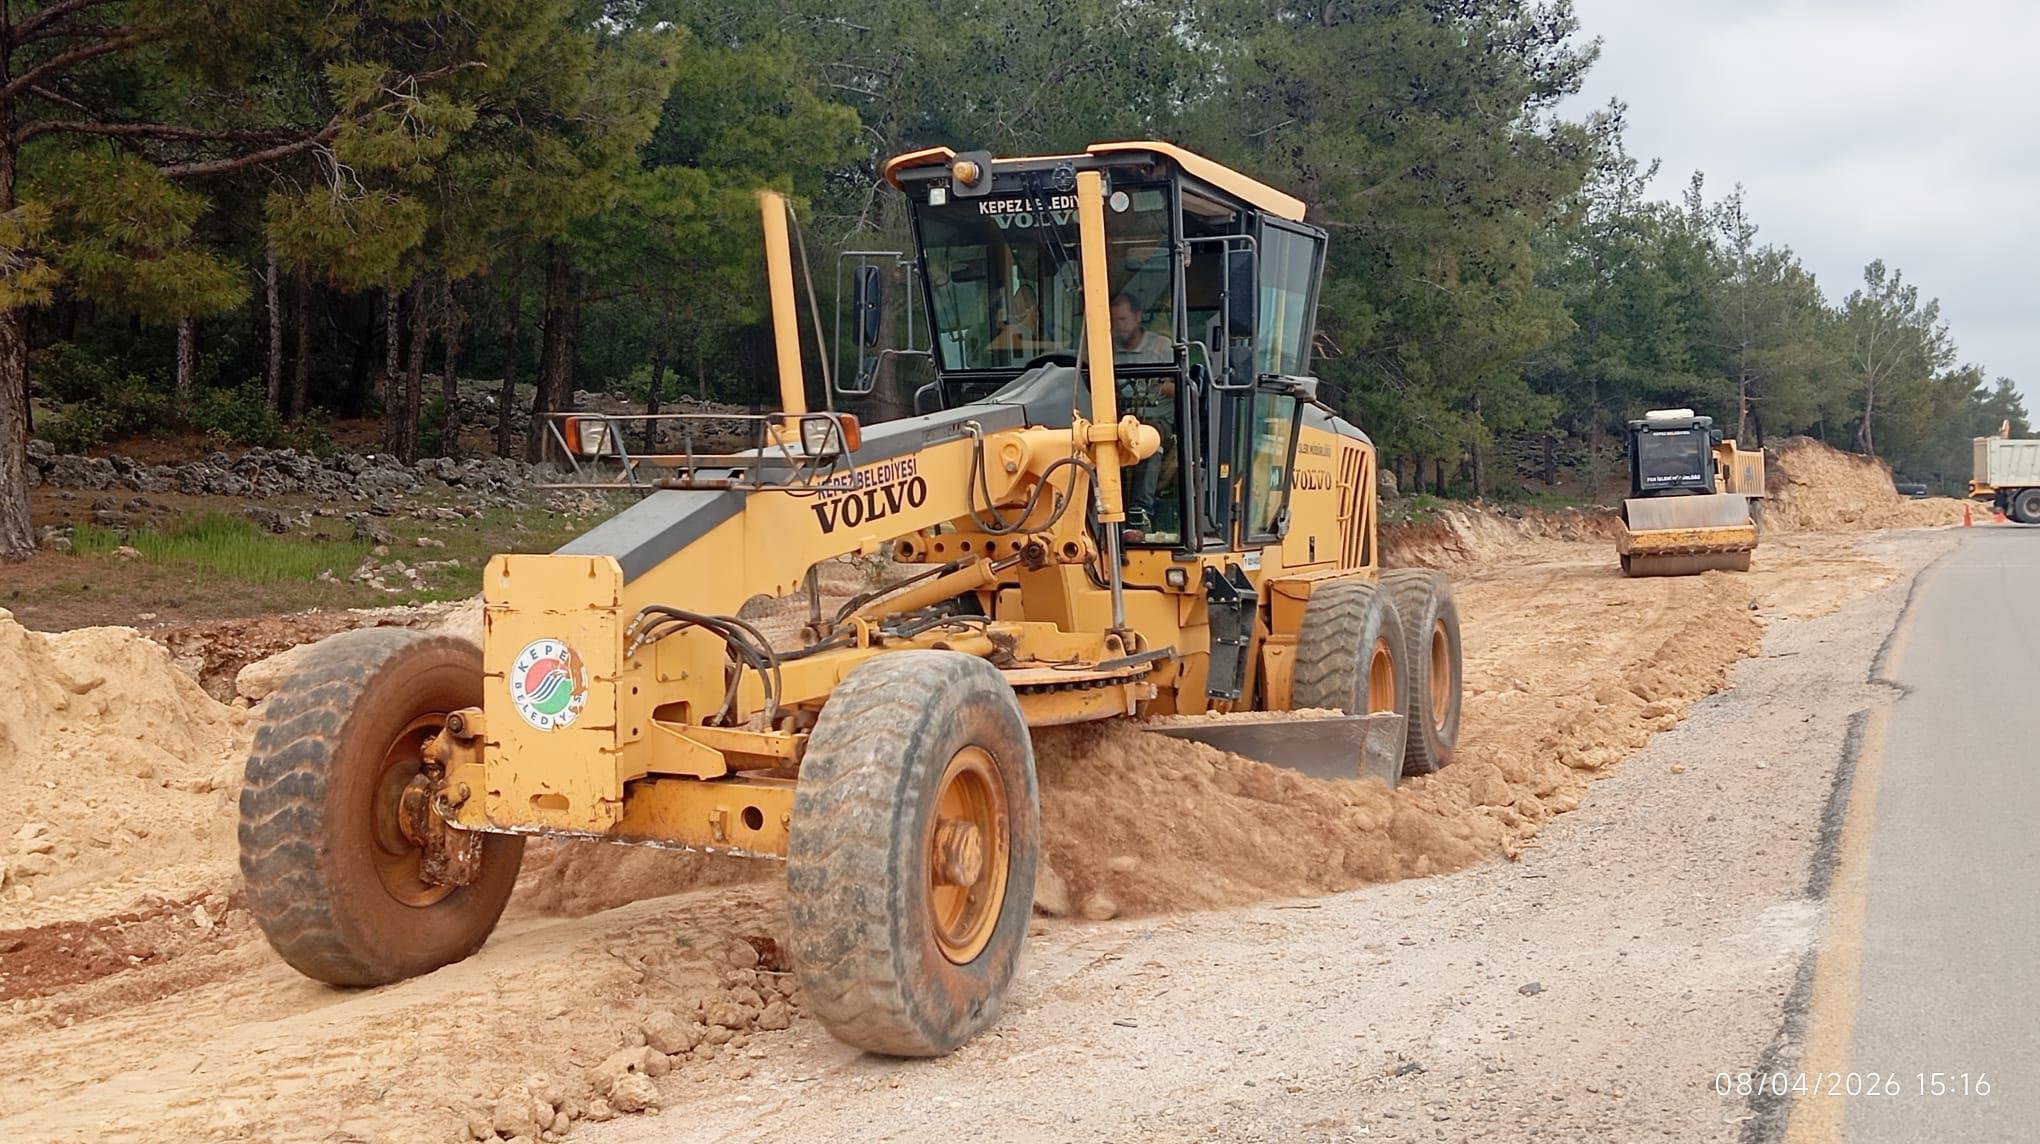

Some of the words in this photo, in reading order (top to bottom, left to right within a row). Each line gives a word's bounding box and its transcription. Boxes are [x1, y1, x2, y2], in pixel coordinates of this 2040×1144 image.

[978, 199, 1023, 215] KEPEZ
[1292, 469, 1331, 490] VOLVO
[811, 476, 927, 534] VOLVO
[518, 645, 568, 673] KEPE
